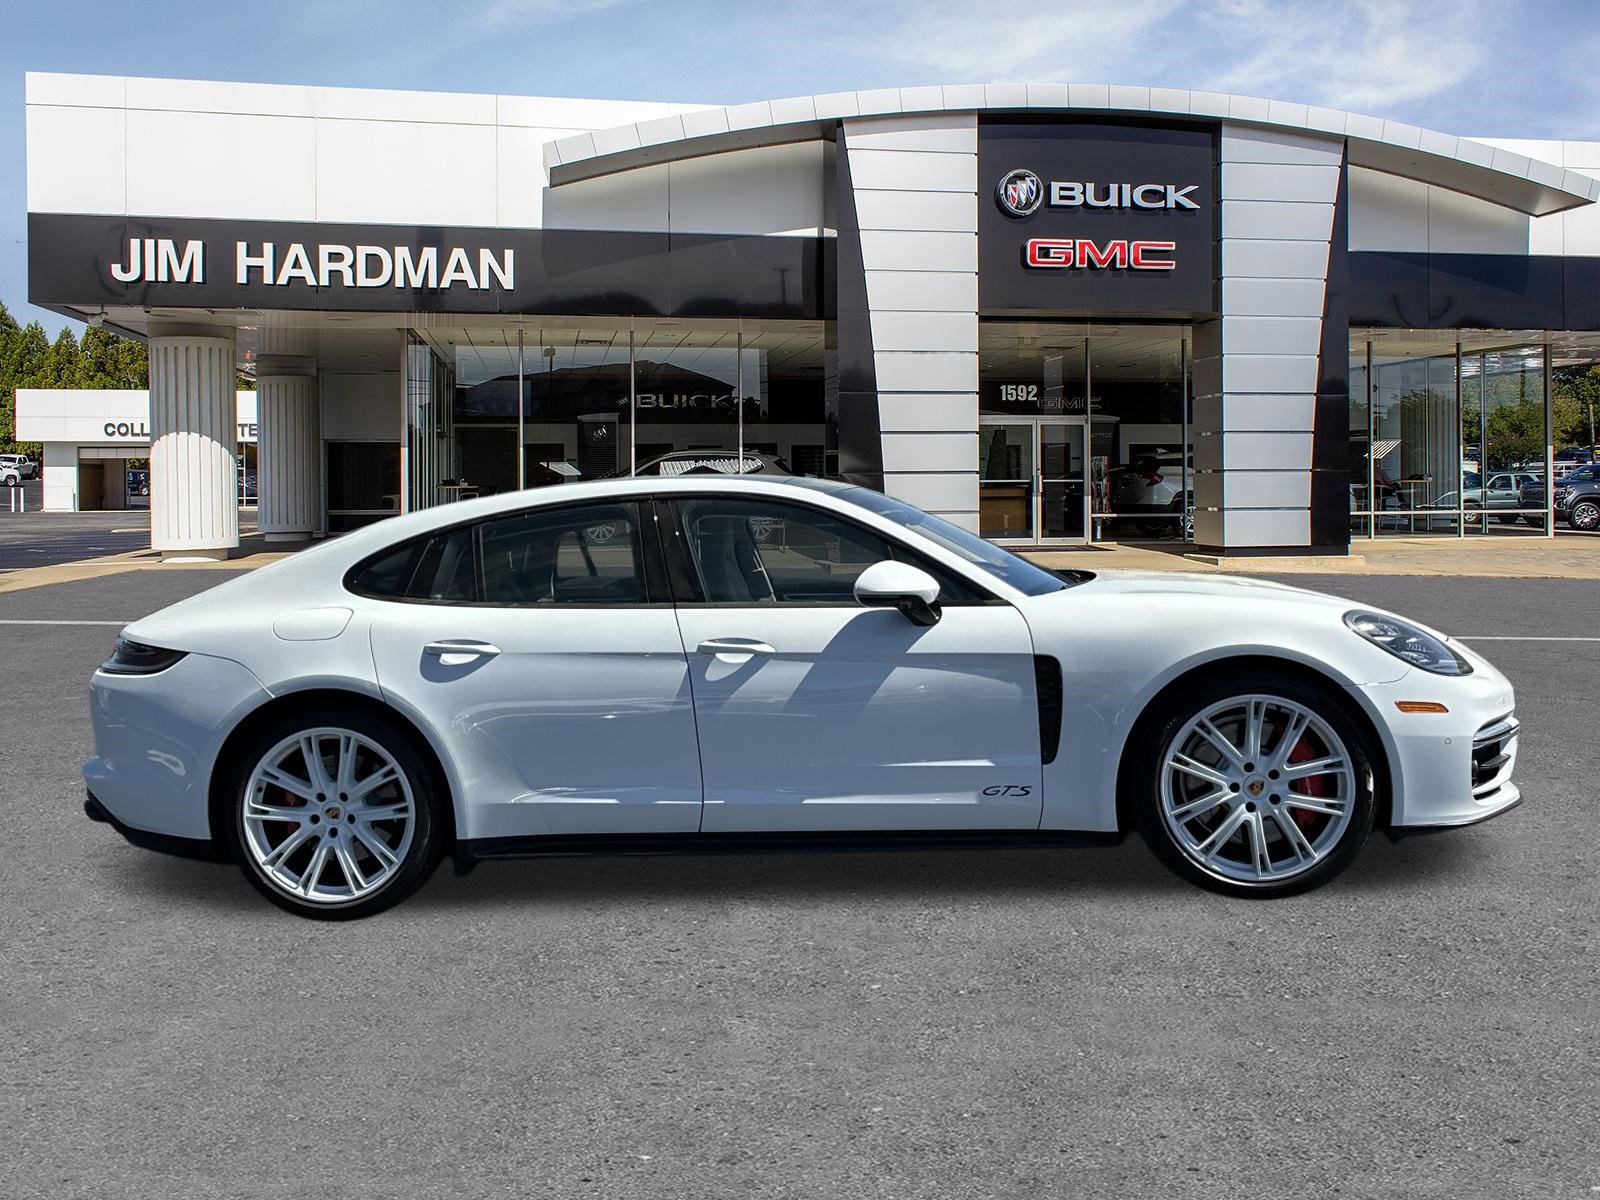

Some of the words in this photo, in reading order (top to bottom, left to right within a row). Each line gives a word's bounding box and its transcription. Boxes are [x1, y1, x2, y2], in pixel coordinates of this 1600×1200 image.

[1050, 181, 1200, 209] BUICK
[1026, 238, 1176, 270] GMC
[111, 238, 205, 284] JIM
[236, 240, 515, 291] HARDMAN
[636, 393, 732, 408] BUICK
[1000, 385, 1038, 401] 1592
[104, 422, 150, 437] COLL
[237, 423, 257, 437] TE
[982, 785, 1033, 797] GTS
